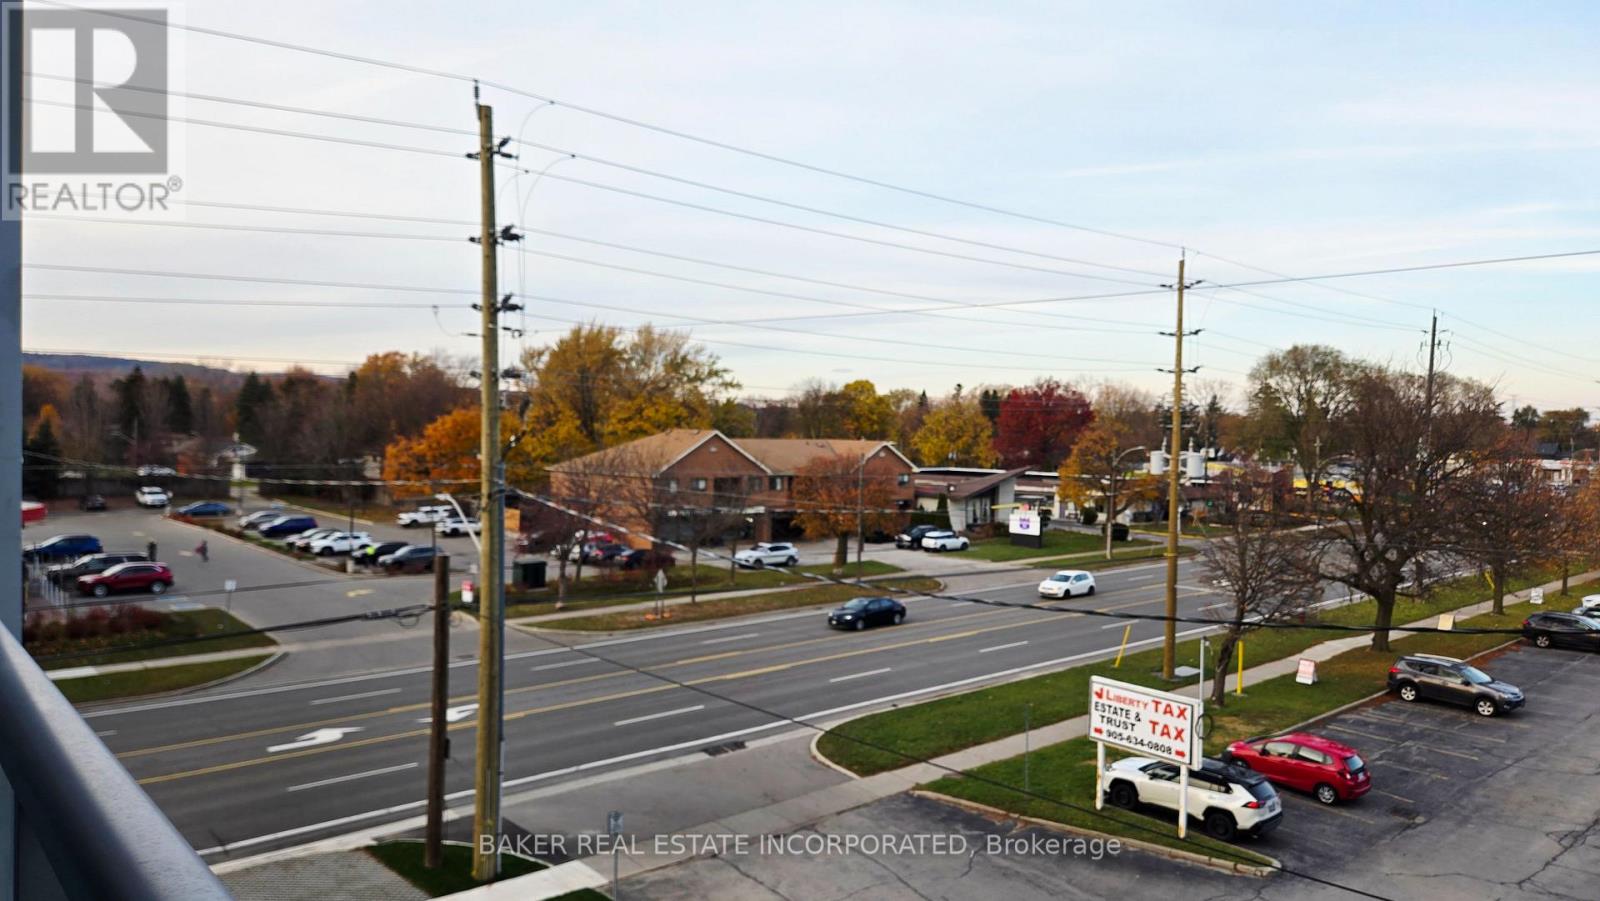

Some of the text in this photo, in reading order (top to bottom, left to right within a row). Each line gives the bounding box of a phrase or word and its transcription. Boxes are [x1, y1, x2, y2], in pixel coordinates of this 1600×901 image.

[1094, 701, 1142, 722] ESTATE &
[1151, 699, 1187, 720] TAX
[1099, 714, 1136, 732] TRUST
[1149, 720, 1185, 742] TAX
